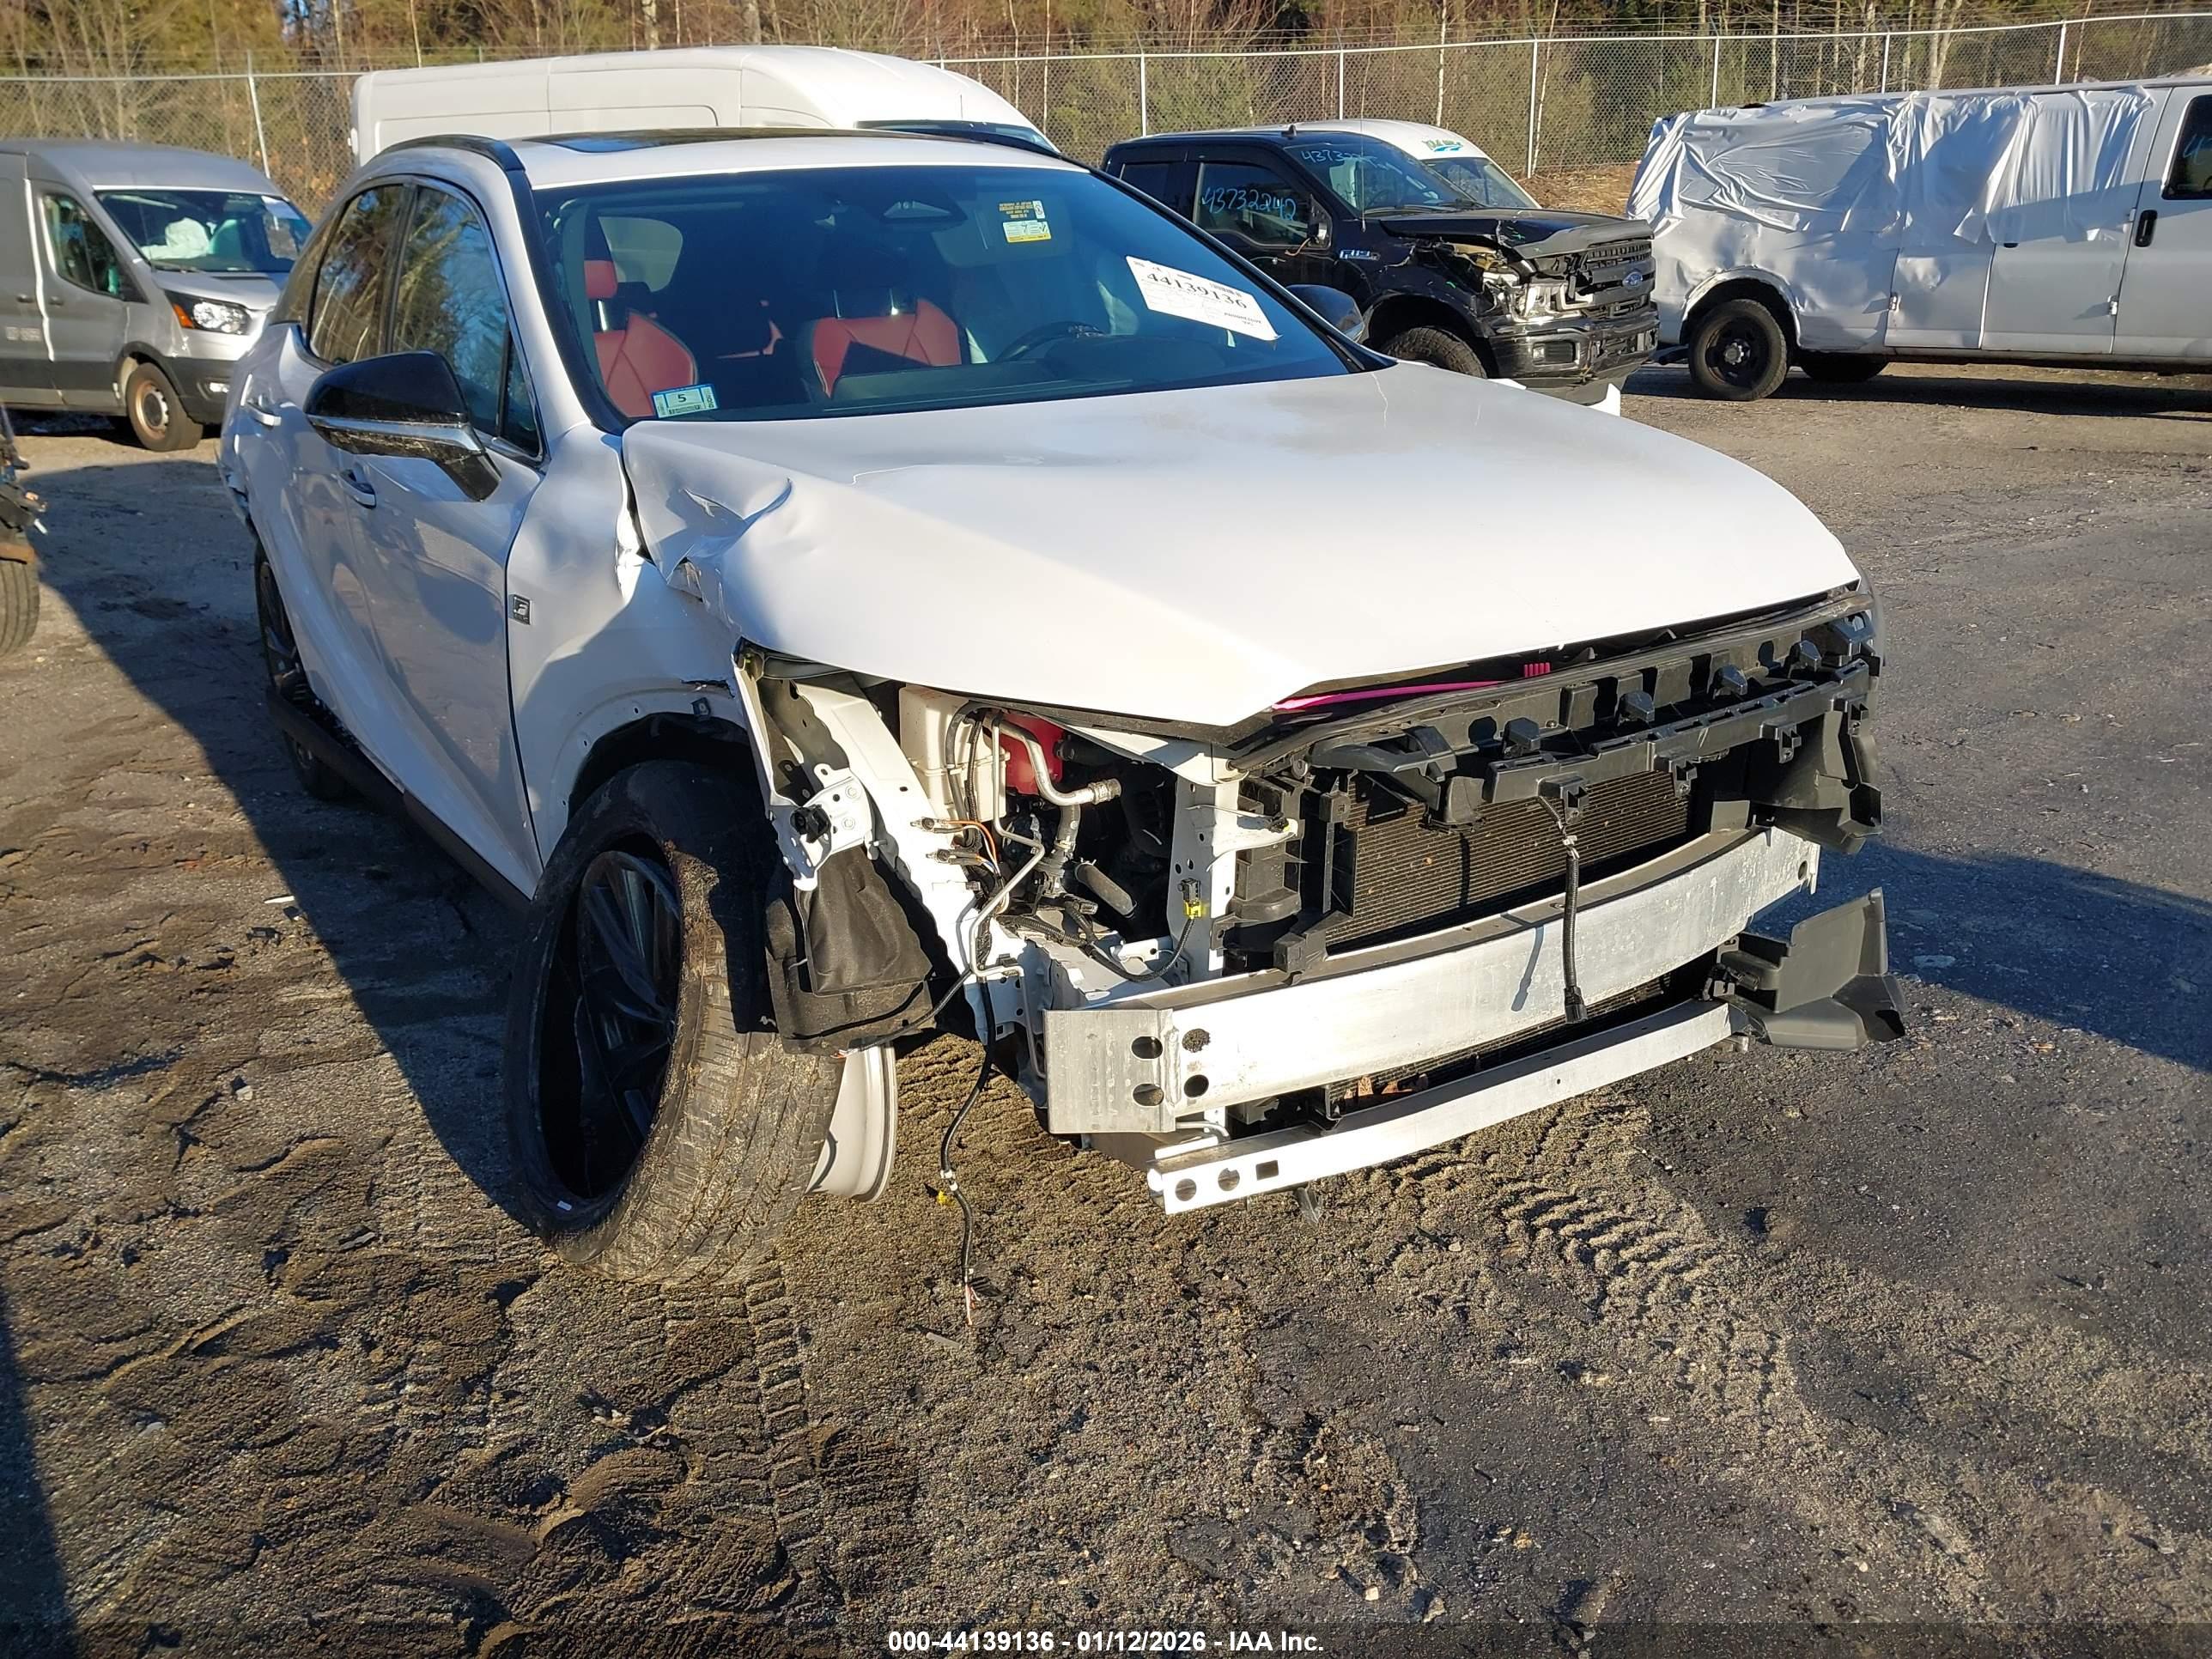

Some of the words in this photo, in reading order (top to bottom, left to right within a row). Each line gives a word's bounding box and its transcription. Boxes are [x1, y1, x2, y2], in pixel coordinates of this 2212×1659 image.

[1202, 187, 1296, 221] 43732242
[1146, 273, 1248, 309] 44139136
[678, 393, 687, 403] 5
